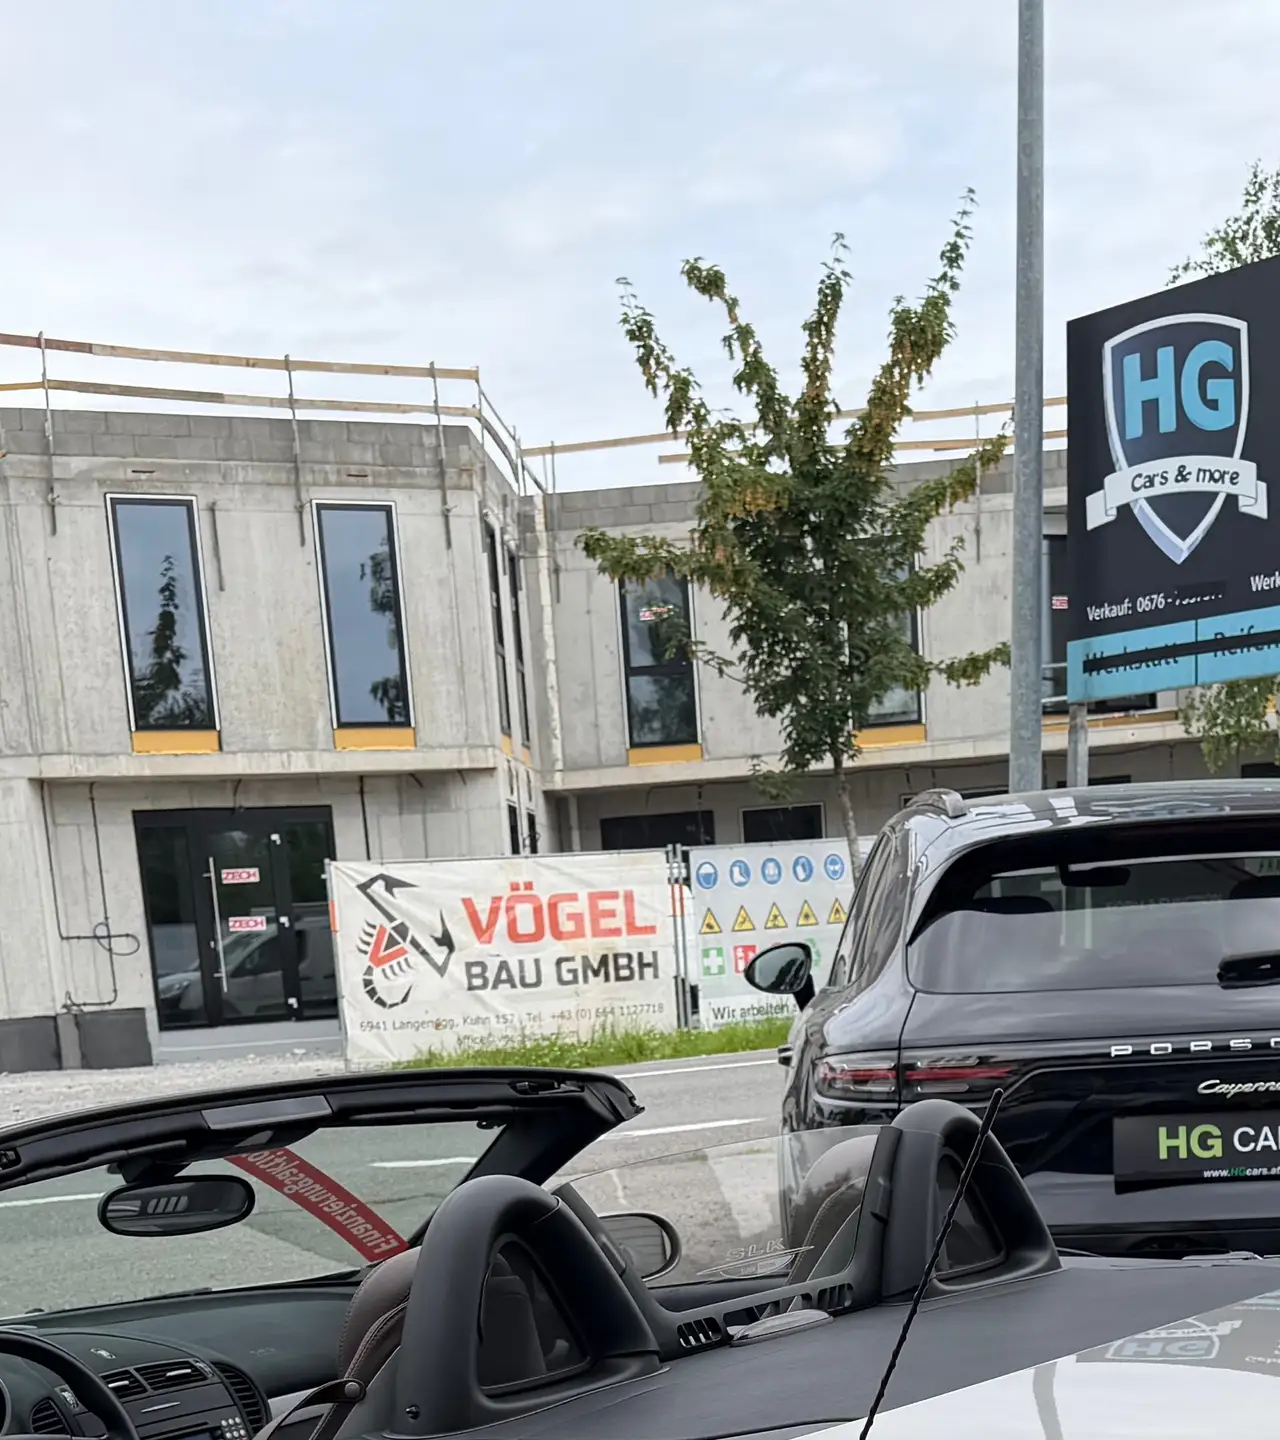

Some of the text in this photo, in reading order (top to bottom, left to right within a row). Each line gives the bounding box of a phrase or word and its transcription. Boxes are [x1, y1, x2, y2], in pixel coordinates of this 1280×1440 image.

[1123, 340, 1236, 440] HG
[1131, 464, 1240, 492] Cars & more
[1087, 598, 1132, 621] Verkauf:
[461, 881, 657, 945] VÖGEL
[464, 951, 660, 991] BAU GMBH
[712, 1006, 736, 1020] Wir
[740, 1001, 790, 1019] arbeiten
[1158, 1124, 1223, 1160] HG
[725, 1237, 785, 1262] SLK
